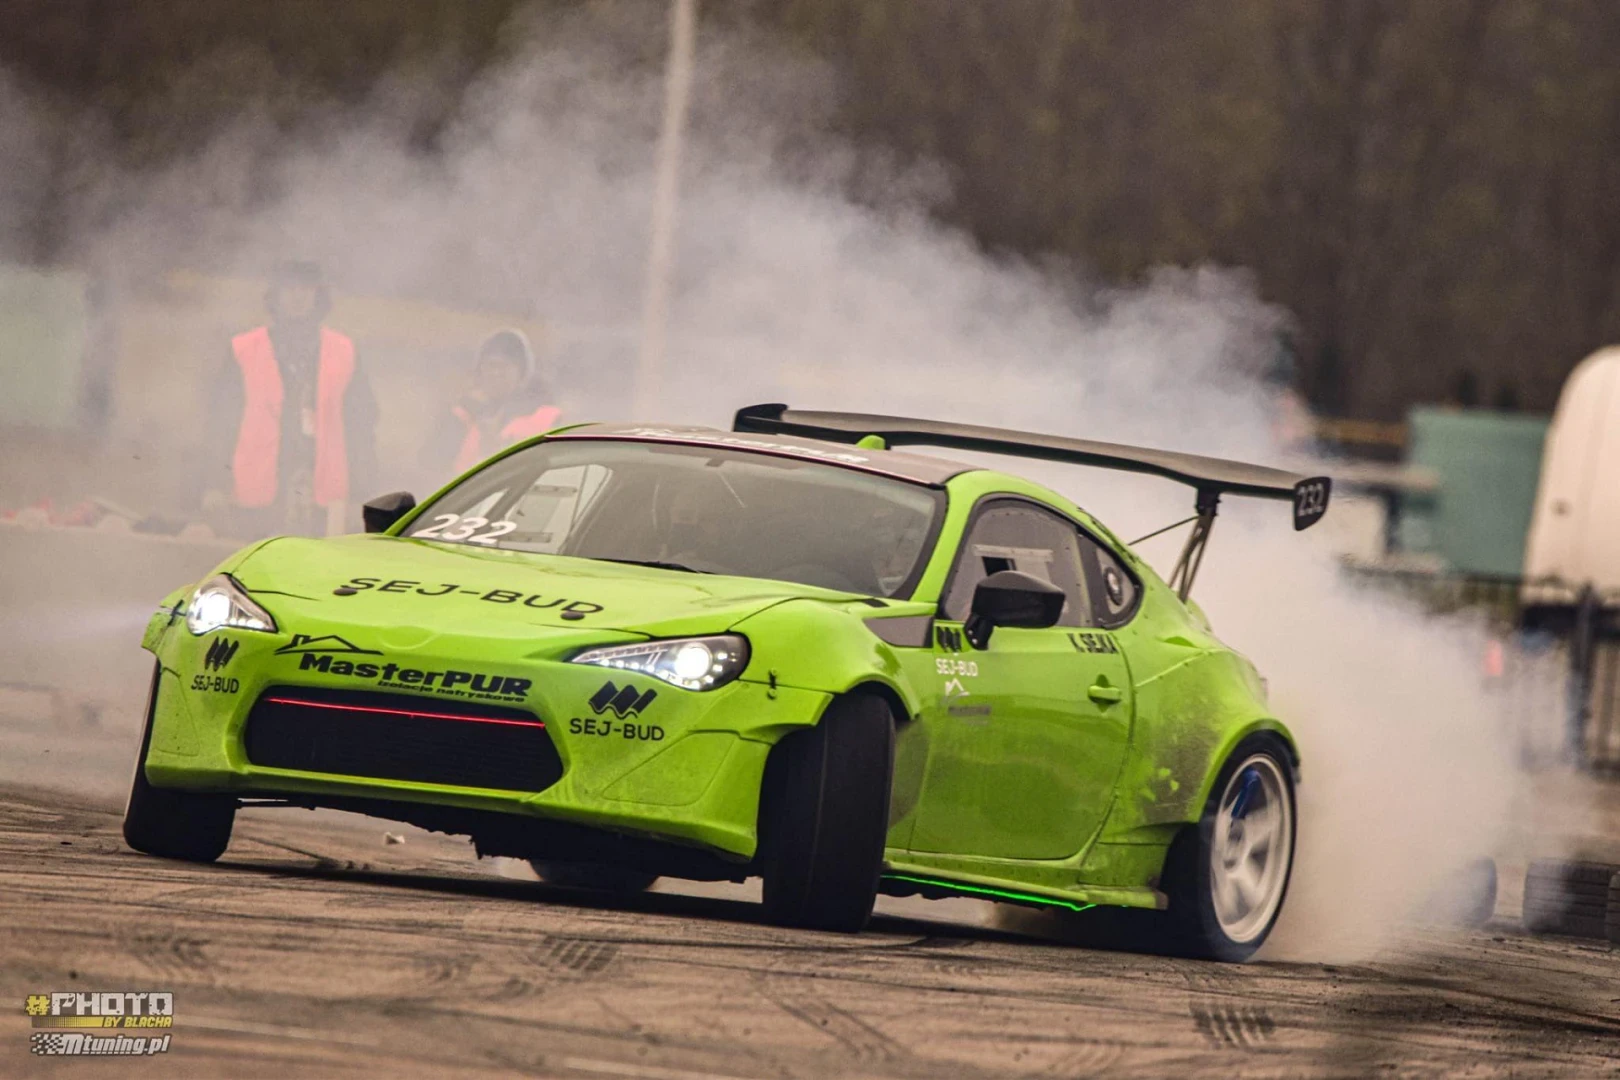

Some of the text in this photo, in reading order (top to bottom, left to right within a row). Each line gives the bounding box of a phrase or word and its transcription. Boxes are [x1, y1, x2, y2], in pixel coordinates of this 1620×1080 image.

[1298, 483, 1323, 516] 232
[410, 513, 517, 544] 232
[340, 578, 604, 614] SEJ-BUD
[299, 652, 532, 697] MasterPUR
[936, 658, 978, 677] SEJ-BUD
[191, 675, 240, 694] SEJ-BUD
[569, 718, 665, 741] SEJ-BUD
